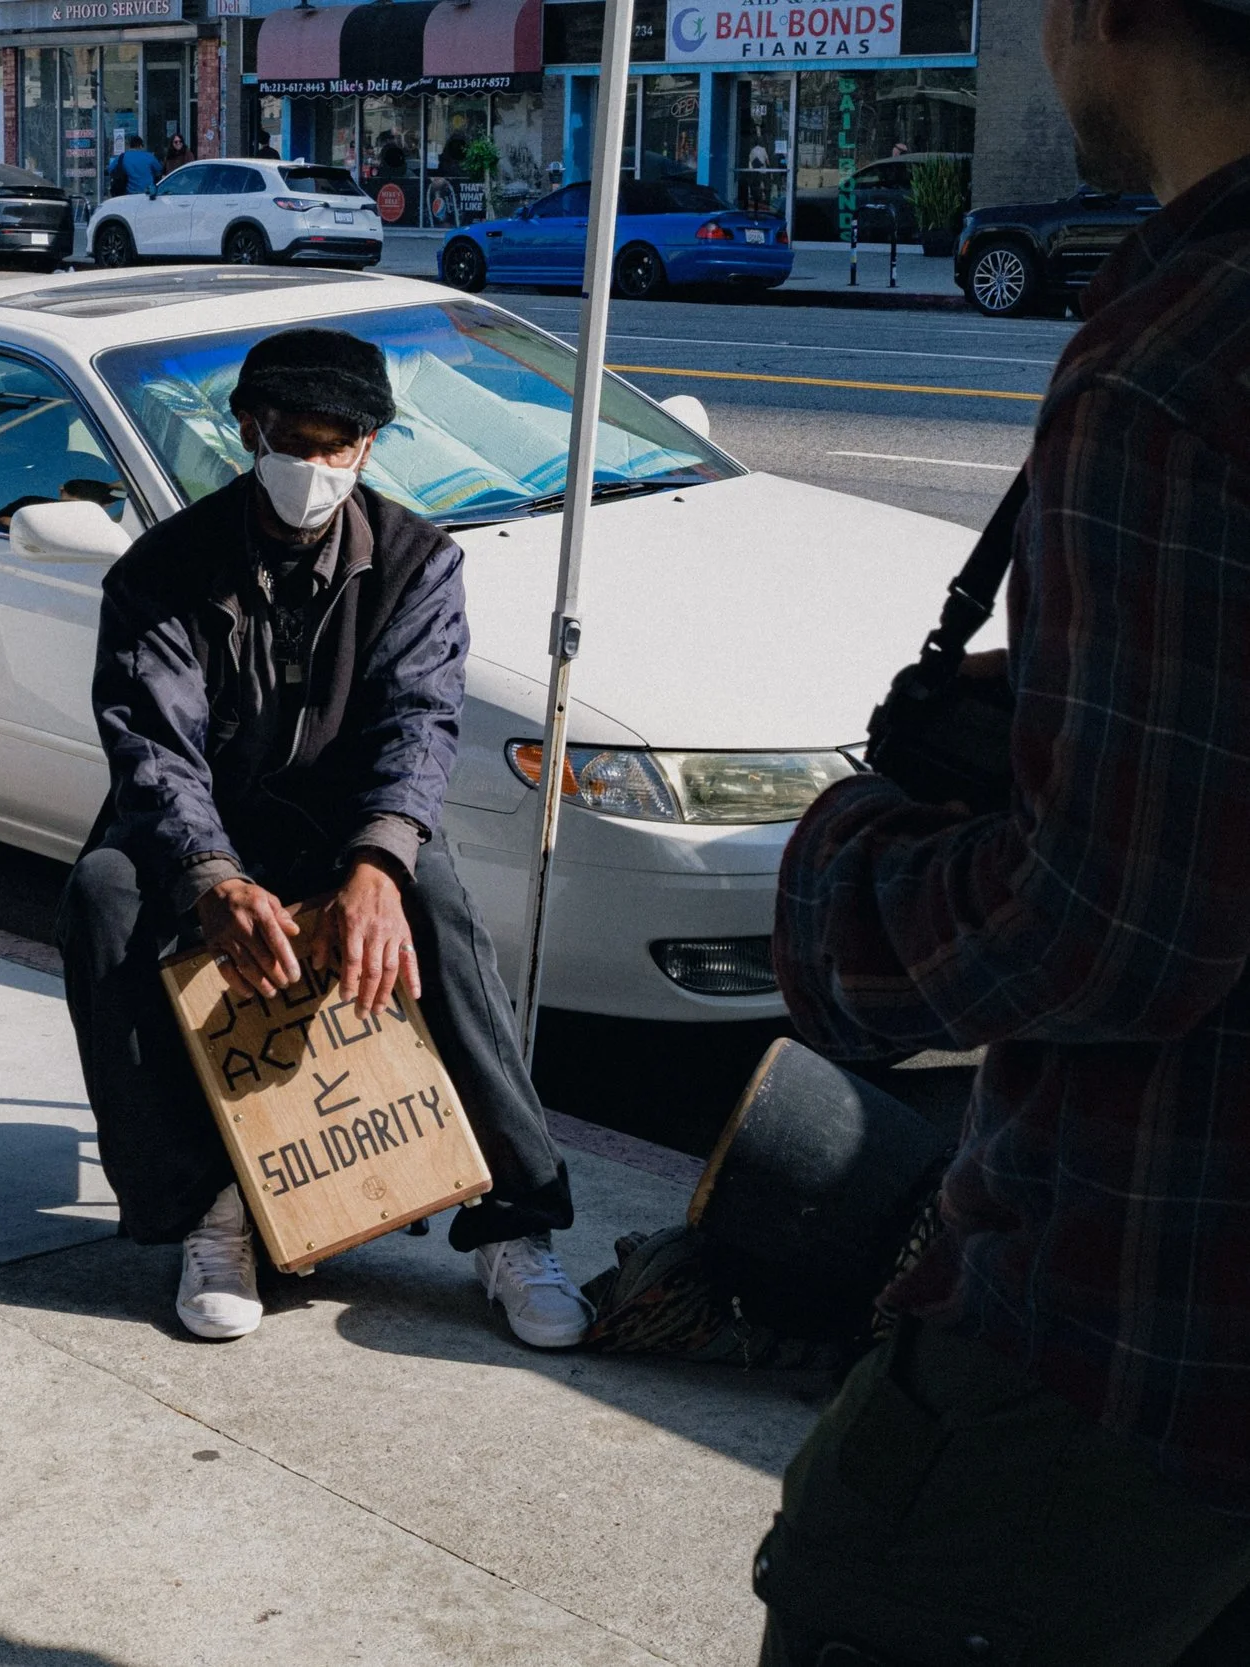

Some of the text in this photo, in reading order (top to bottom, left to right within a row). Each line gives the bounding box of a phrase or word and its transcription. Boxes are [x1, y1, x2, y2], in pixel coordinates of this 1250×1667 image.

[51, 0, 171, 20] & PHOTO SERVICES
[635, 25, 654, 37] 234
[716, 3, 896, 40] BAIL BONDS
[742, 39, 870, 57] FIANZAS
[330, 79, 364, 93] Mike's
[367, 78, 389, 92] Deli
[391, 80, 403, 92] #2
[670, 97, 700, 116] OPEN
[838, 76, 856, 149] BAIL
[460, 192, 484, 201] WHAT
[464, 202, 483, 211] LIKE
[222, 987, 408, 1092] ACTION
[258, 1085, 445, 1196] SOLIDARITY
